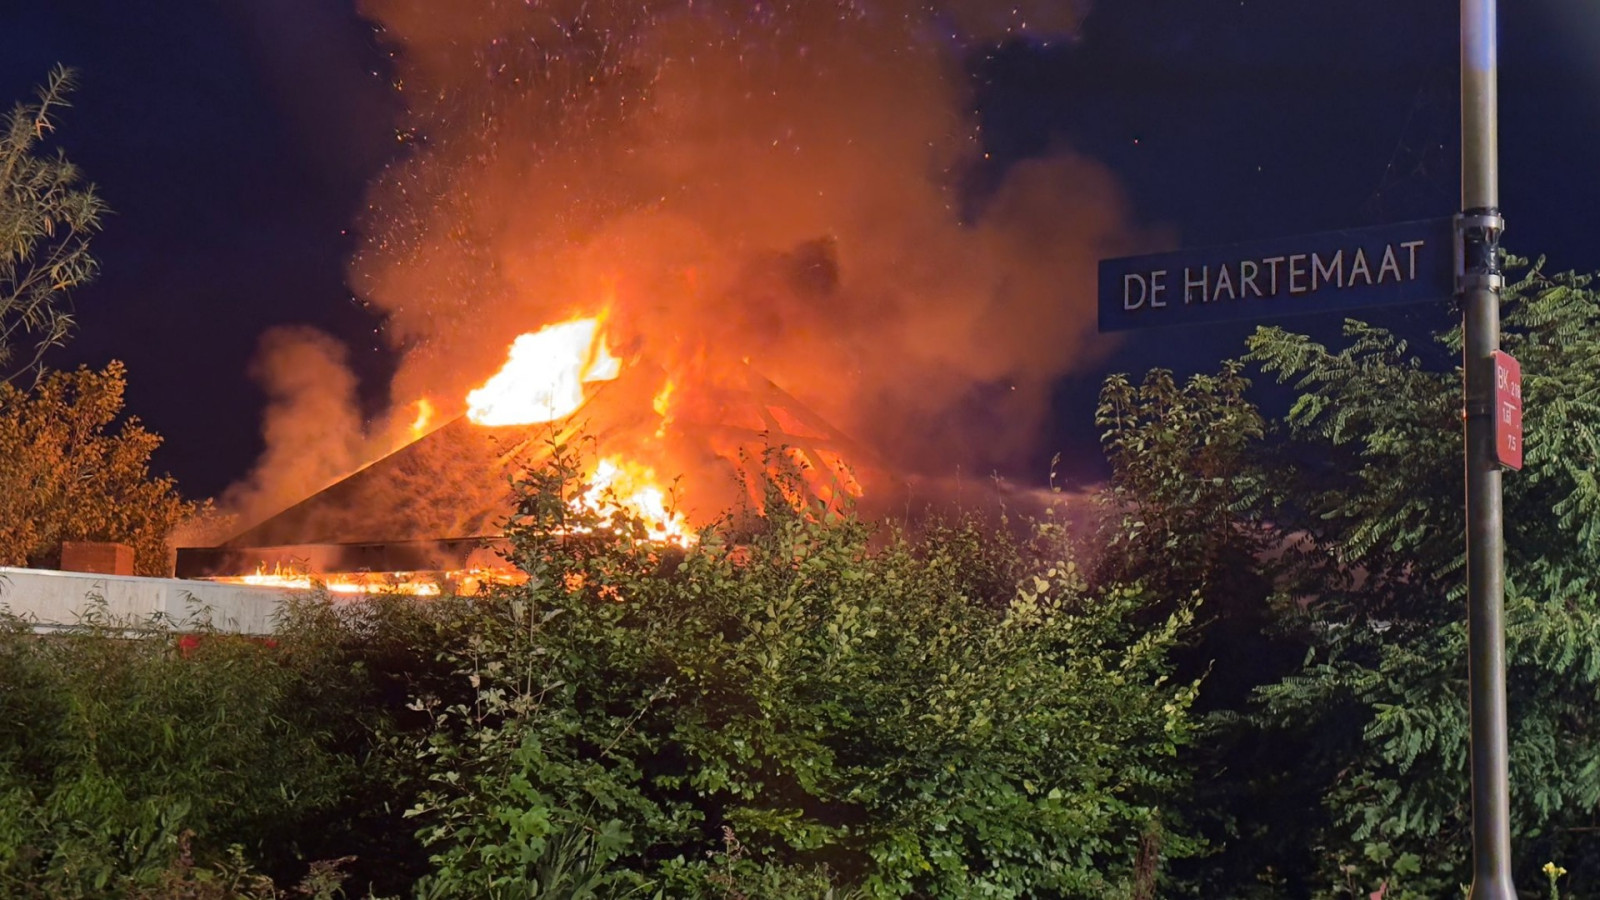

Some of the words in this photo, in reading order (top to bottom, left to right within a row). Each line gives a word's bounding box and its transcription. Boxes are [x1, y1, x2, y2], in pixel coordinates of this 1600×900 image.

[1124, 270, 1167, 310] DE
[1184, 240, 1424, 304] HARTEMAAT
[1498, 366, 1509, 392] BK
